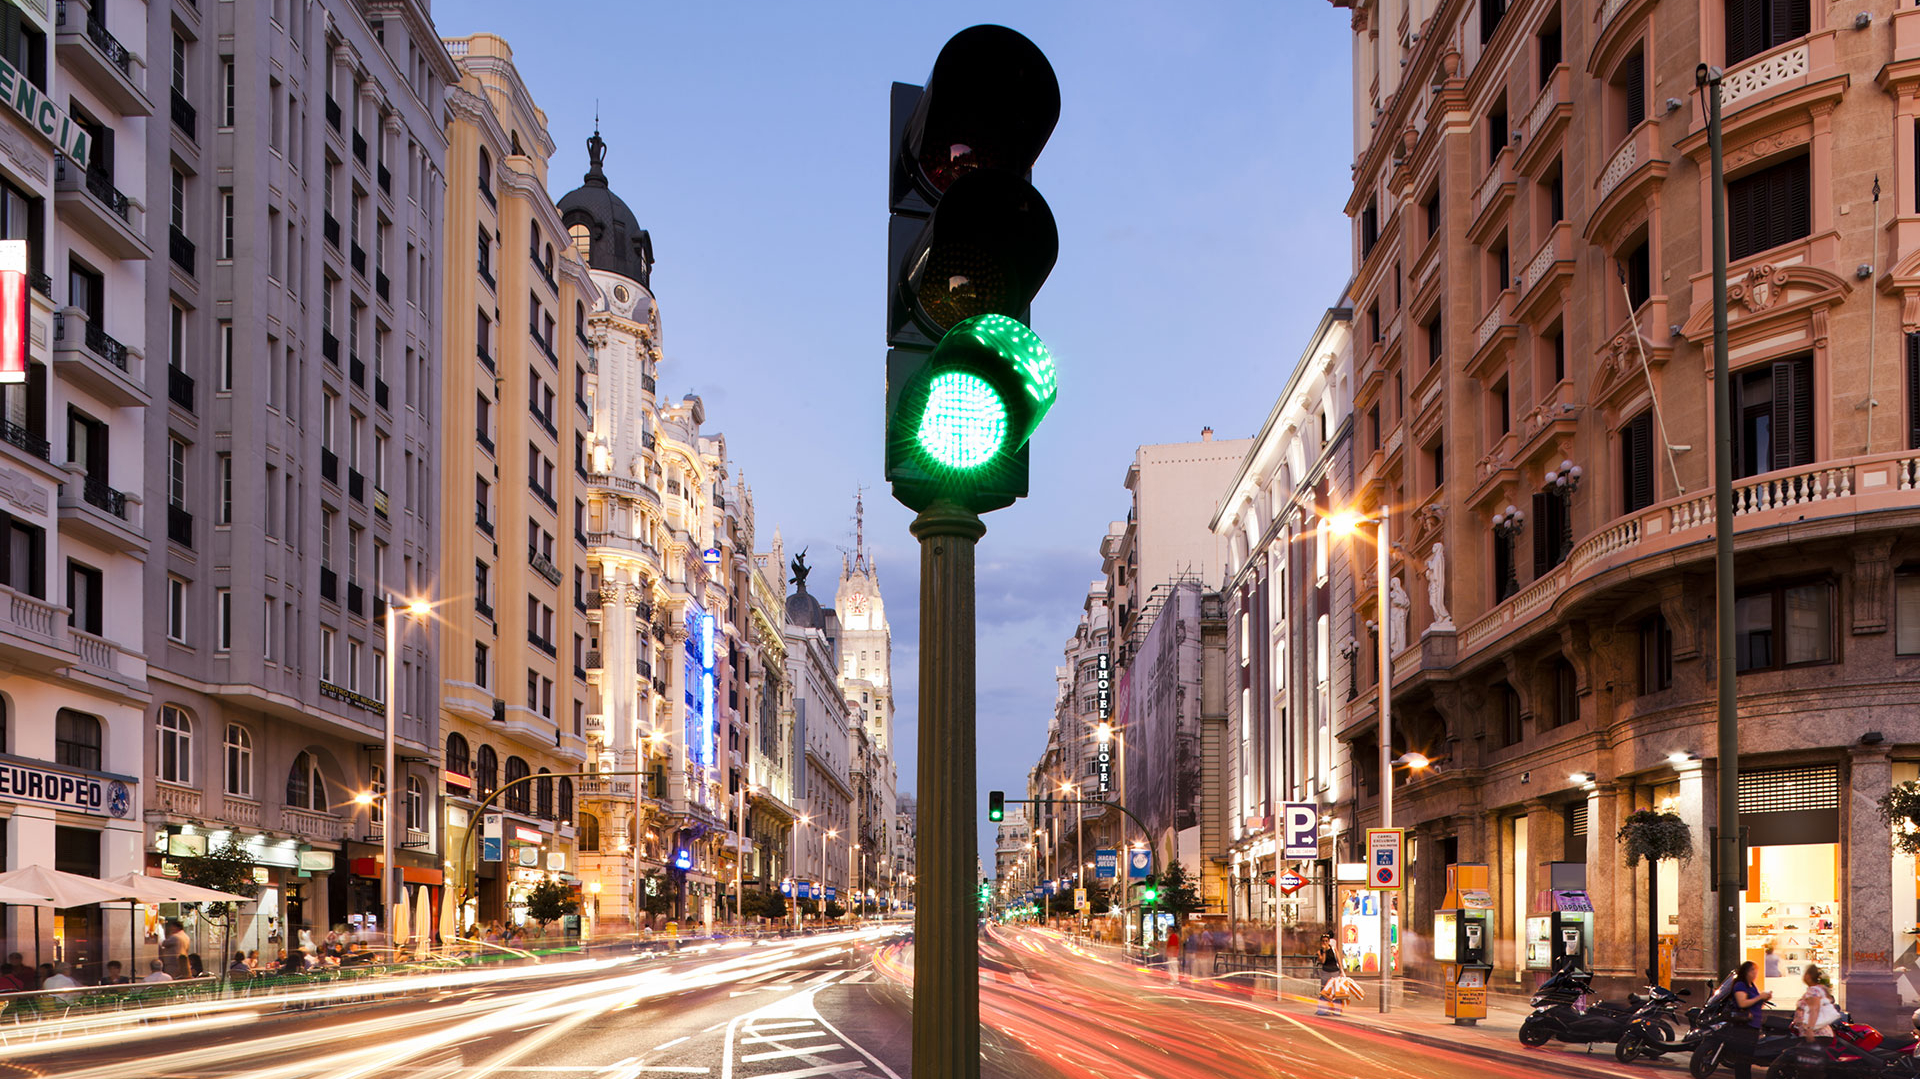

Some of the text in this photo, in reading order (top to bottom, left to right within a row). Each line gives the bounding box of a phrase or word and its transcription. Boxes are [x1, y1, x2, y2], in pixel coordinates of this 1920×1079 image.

[320, 681, 349, 697] CENTRO
[350, 692, 360, 700] DE
[1098, 670, 1108, 719] HOTEL
[0, 766, 101, 807] EUROPEO
[1099, 743, 1109, 792] HOTEL
[1286, 807, 1316, 846] P
